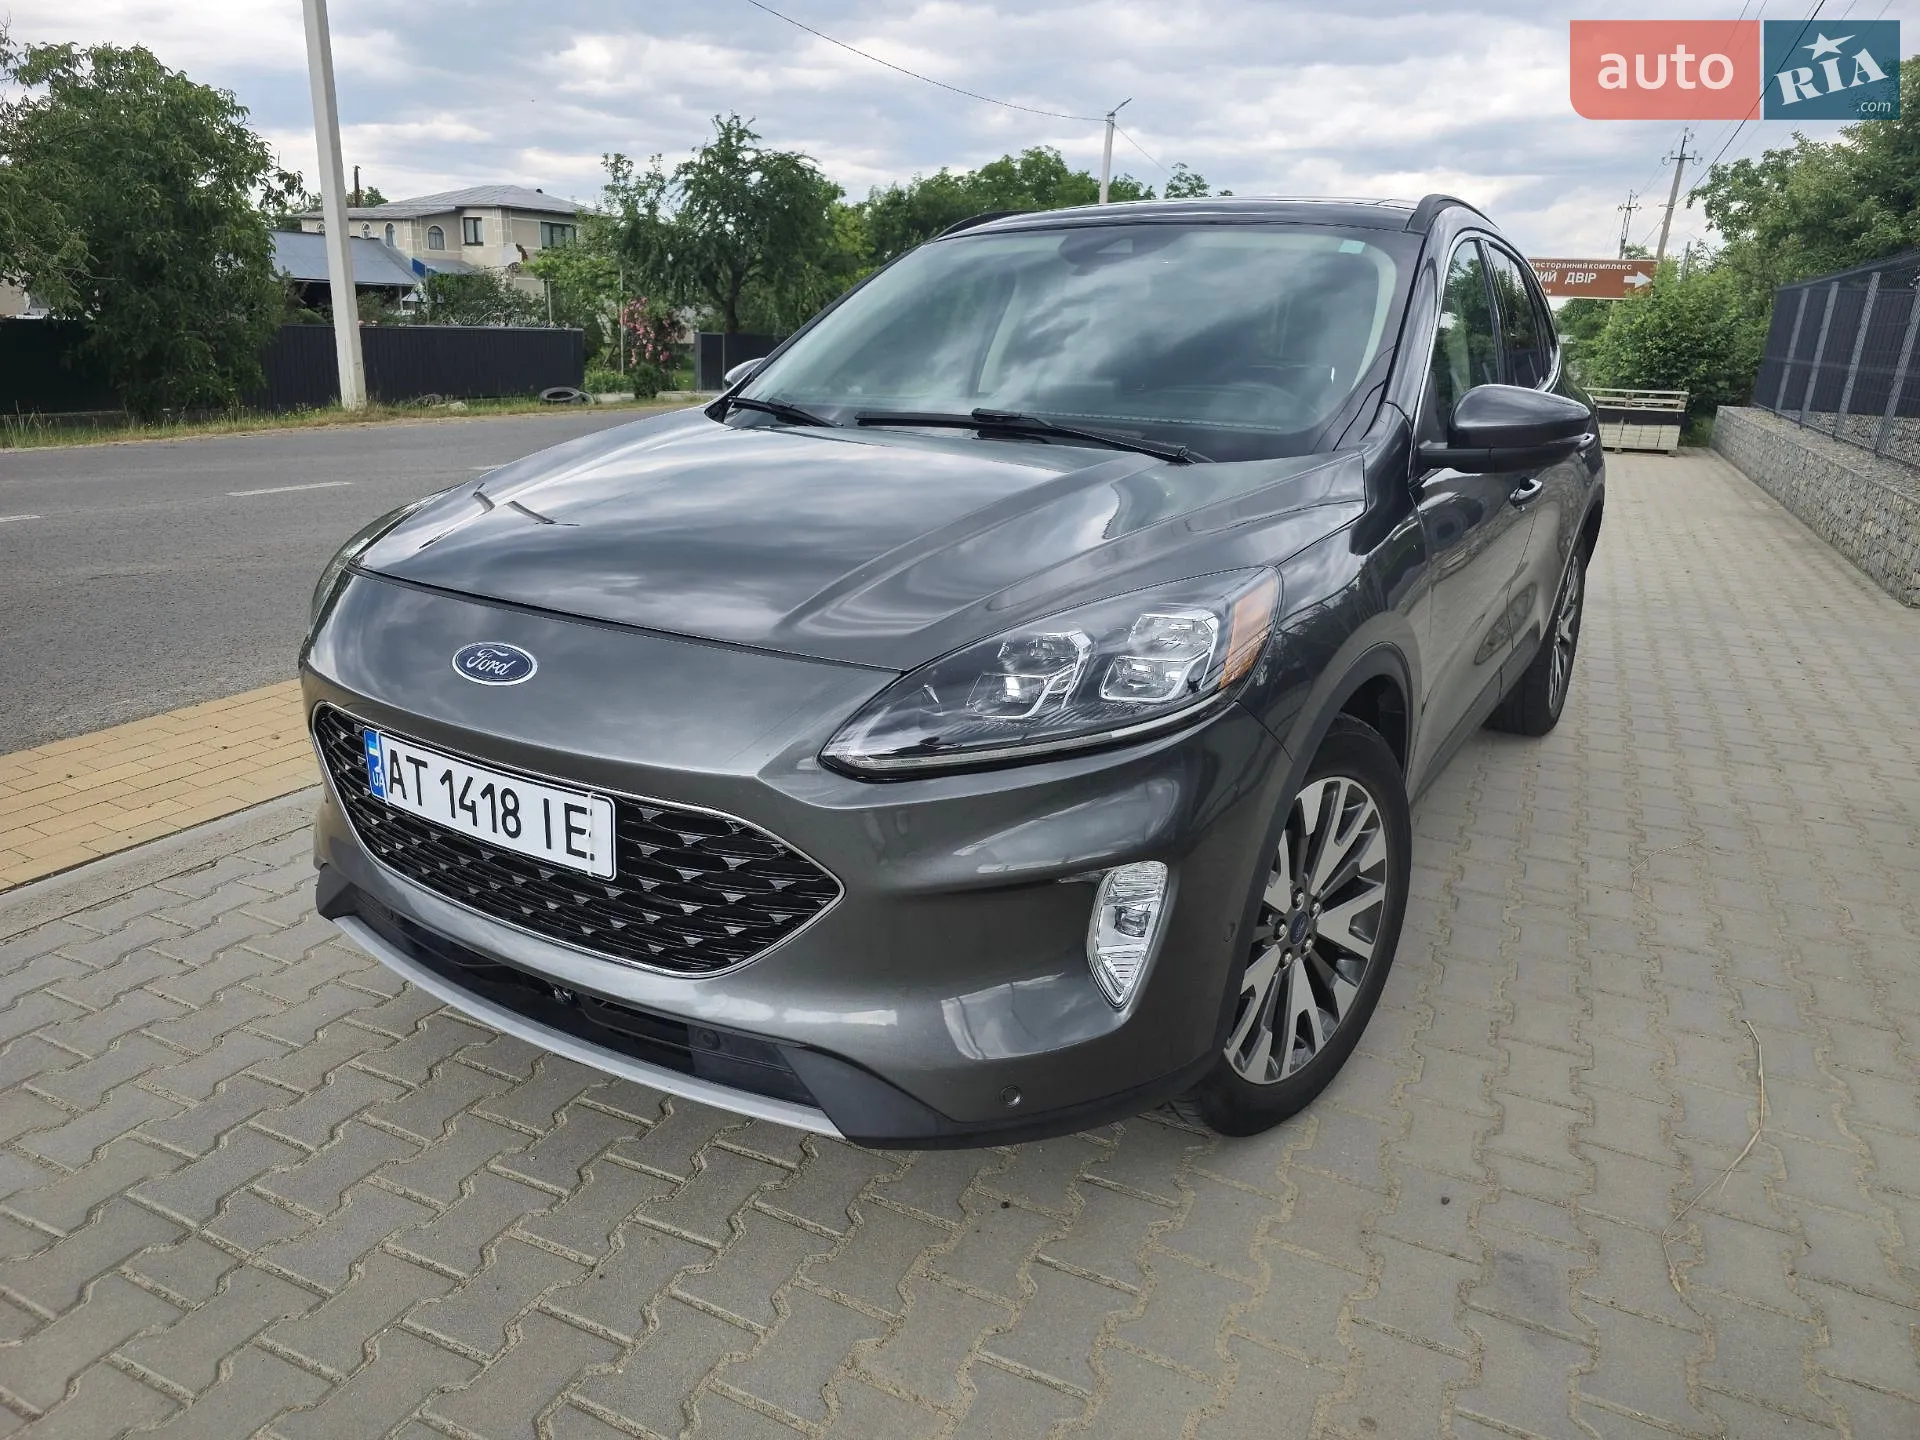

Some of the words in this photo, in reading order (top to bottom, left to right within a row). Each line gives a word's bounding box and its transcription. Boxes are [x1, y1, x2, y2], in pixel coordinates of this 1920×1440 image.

[1588, 263, 1633, 271] комплекс
[1564, 272, 1597, 284] ДВІР
[466, 648, 517, 676] Ford
[389, 749, 428, 807] AT
[440, 769, 522, 838] 1418
[543, 797, 595, 861] IE
